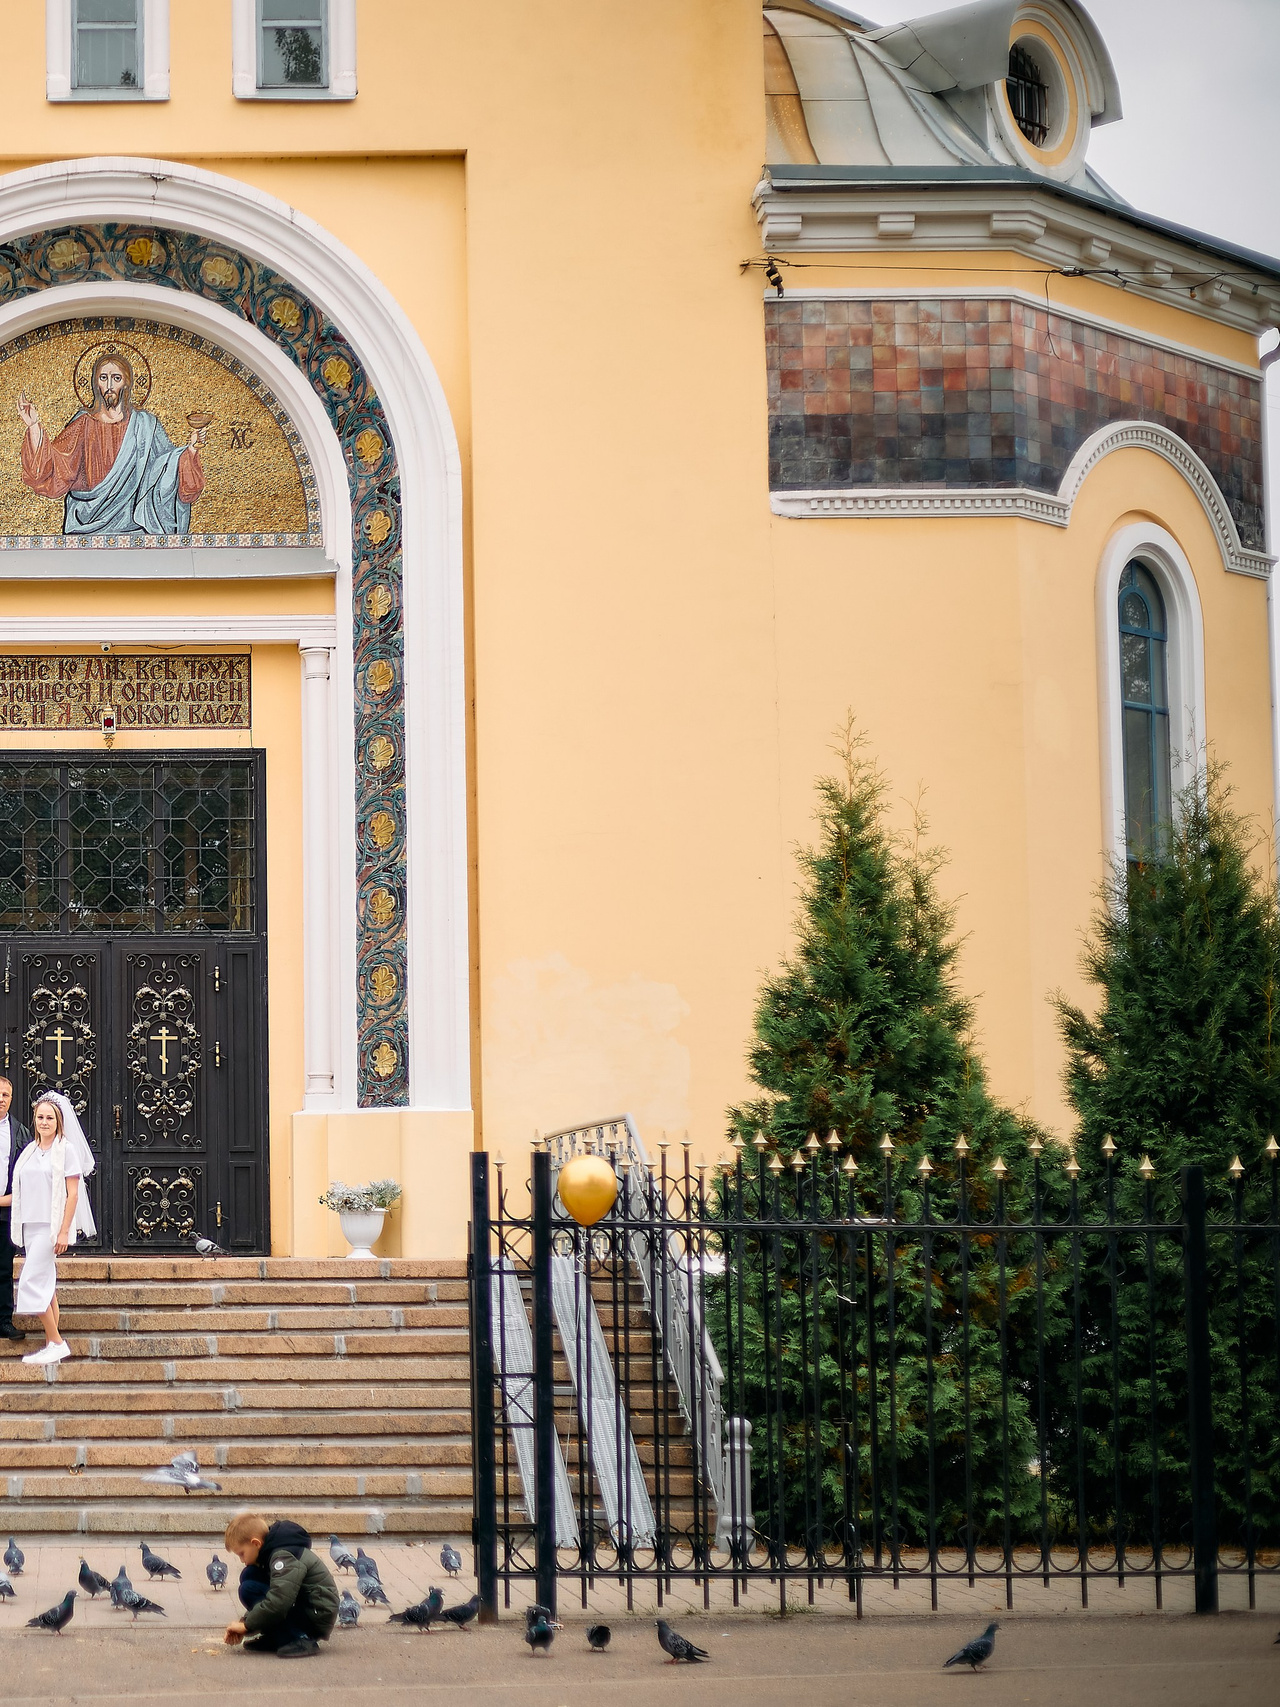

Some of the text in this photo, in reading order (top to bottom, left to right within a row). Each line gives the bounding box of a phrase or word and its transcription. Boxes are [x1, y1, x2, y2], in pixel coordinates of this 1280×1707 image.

[58, 659, 78, 680] КО
[99, 683, 113, 702] И
[32, 704, 45, 725] И
[57, 703, 71, 725] Я
